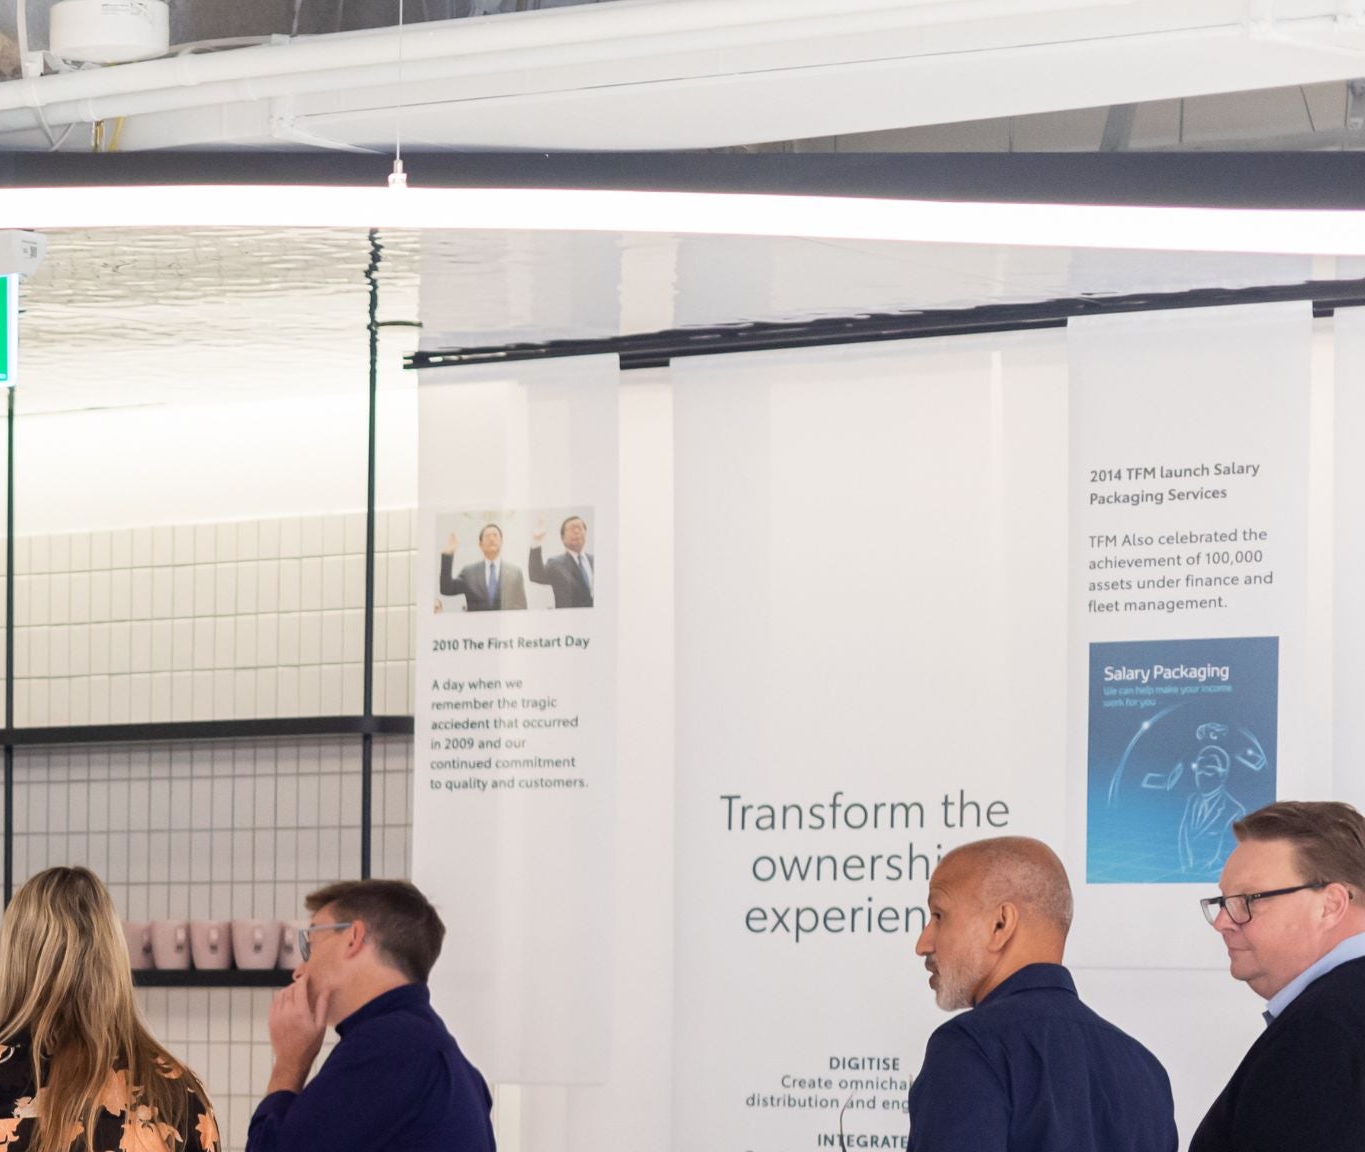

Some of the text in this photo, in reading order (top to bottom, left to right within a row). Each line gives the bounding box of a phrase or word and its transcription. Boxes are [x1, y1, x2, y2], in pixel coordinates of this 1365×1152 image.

[1090, 463, 1260, 482] 2014 TFM launch Salary
[1090, 488, 1227, 506] Packaging Services
[1089, 529, 1267, 548] TFM Also celebrated the
[1089, 551, 1263, 569] achievement of 100,000
[1089, 572, 1273, 591] assets under finance and
[1088, 597, 1228, 613] fleet management.
[433, 636, 589, 651] 2010 The First Restart Day
[1104, 664, 1229, 683] Salary Packaging
[432, 679, 522, 692] A day when we
[432, 697, 557, 710] remember the tragic
[432, 717, 579, 730] acciedent that occurred
[431, 738, 526, 750] in 2009 and our
[430, 757, 576, 769] continued commitment
[430, 778, 589, 791] to quality and customers.
[720, 790, 1009, 831] Transform the
[753, 843, 943, 881] ownershi
[745, 898, 928, 942] experien
[830, 1057, 900, 1071] DIGITISE
[781, 1075, 913, 1090] Create omnicha
[746, 1094, 909, 1113] distribution and eng
